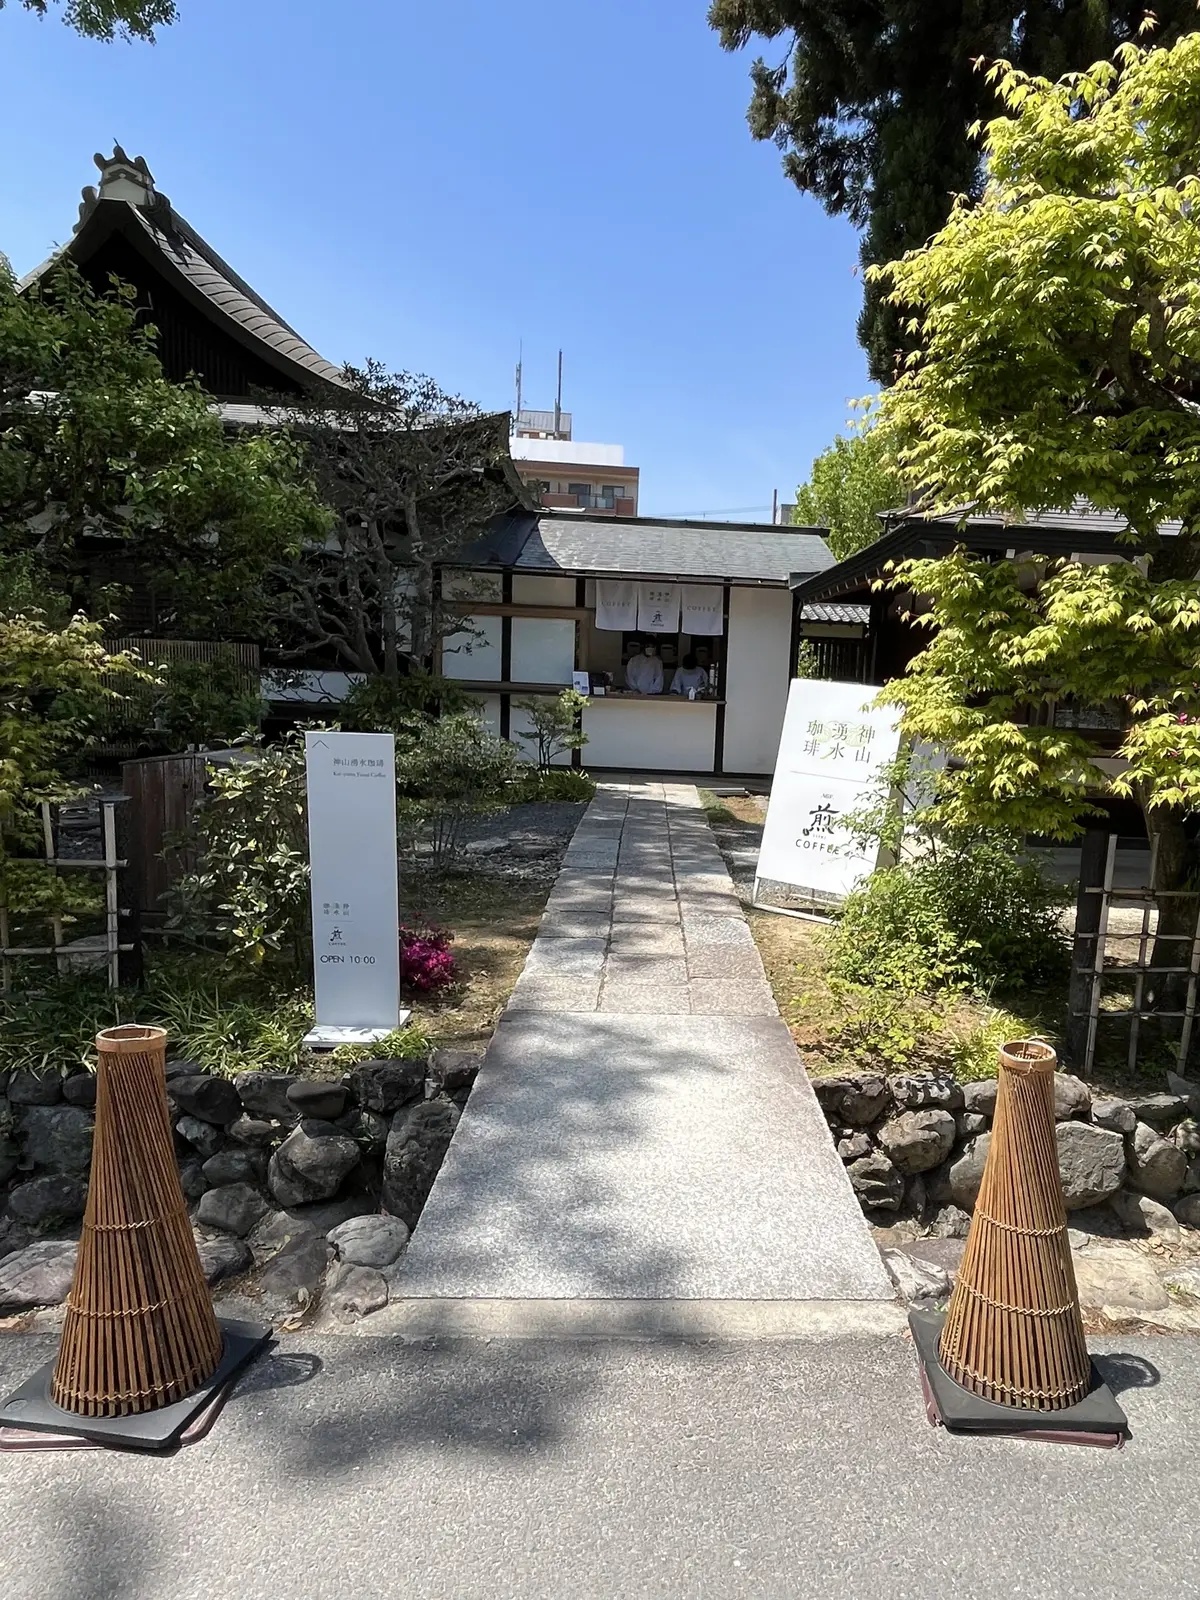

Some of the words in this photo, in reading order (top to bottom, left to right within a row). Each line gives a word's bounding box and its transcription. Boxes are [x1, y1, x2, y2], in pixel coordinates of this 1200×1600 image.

[803, 720, 824, 757] 珈琲
[829, 723, 848, 760] 湧水
[855, 725, 876, 764] 神山
[803, 803, 840, 836] 煎
[796, 839, 840, 855] COFFEE
[320, 954, 345, 964] OPEN
[350, 955, 376, 965] 10:00
